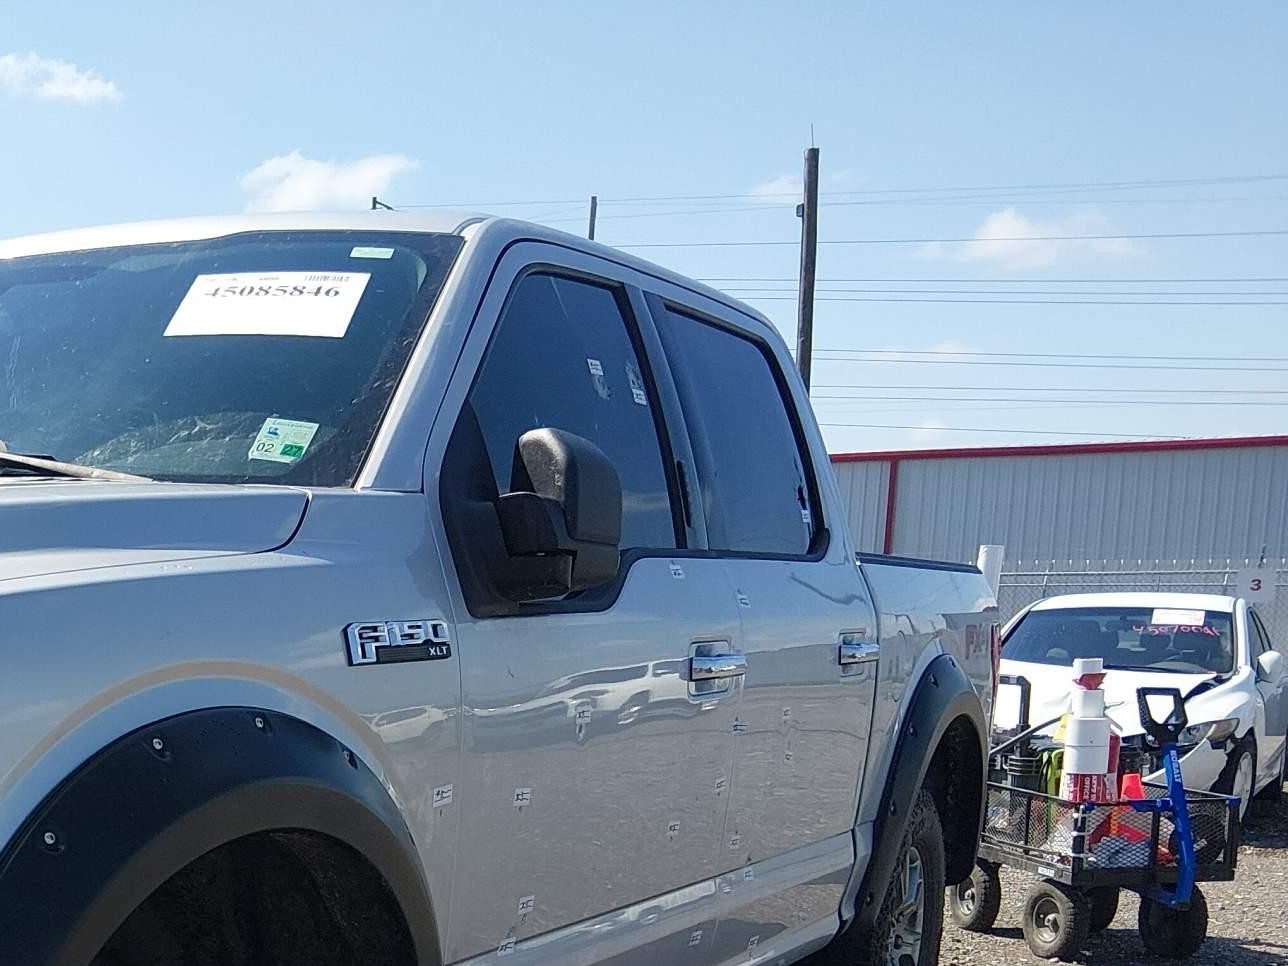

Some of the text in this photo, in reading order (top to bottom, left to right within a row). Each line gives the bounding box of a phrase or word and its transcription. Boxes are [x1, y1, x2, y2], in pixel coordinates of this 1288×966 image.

[205, 285, 340, 298] 45085846
[256, 442, 274, 453] 02
[1250, 579, 1261, 591] 3
[428, 646, 448, 656] XLT
[1170, 750, 1182, 783] KOBALT
